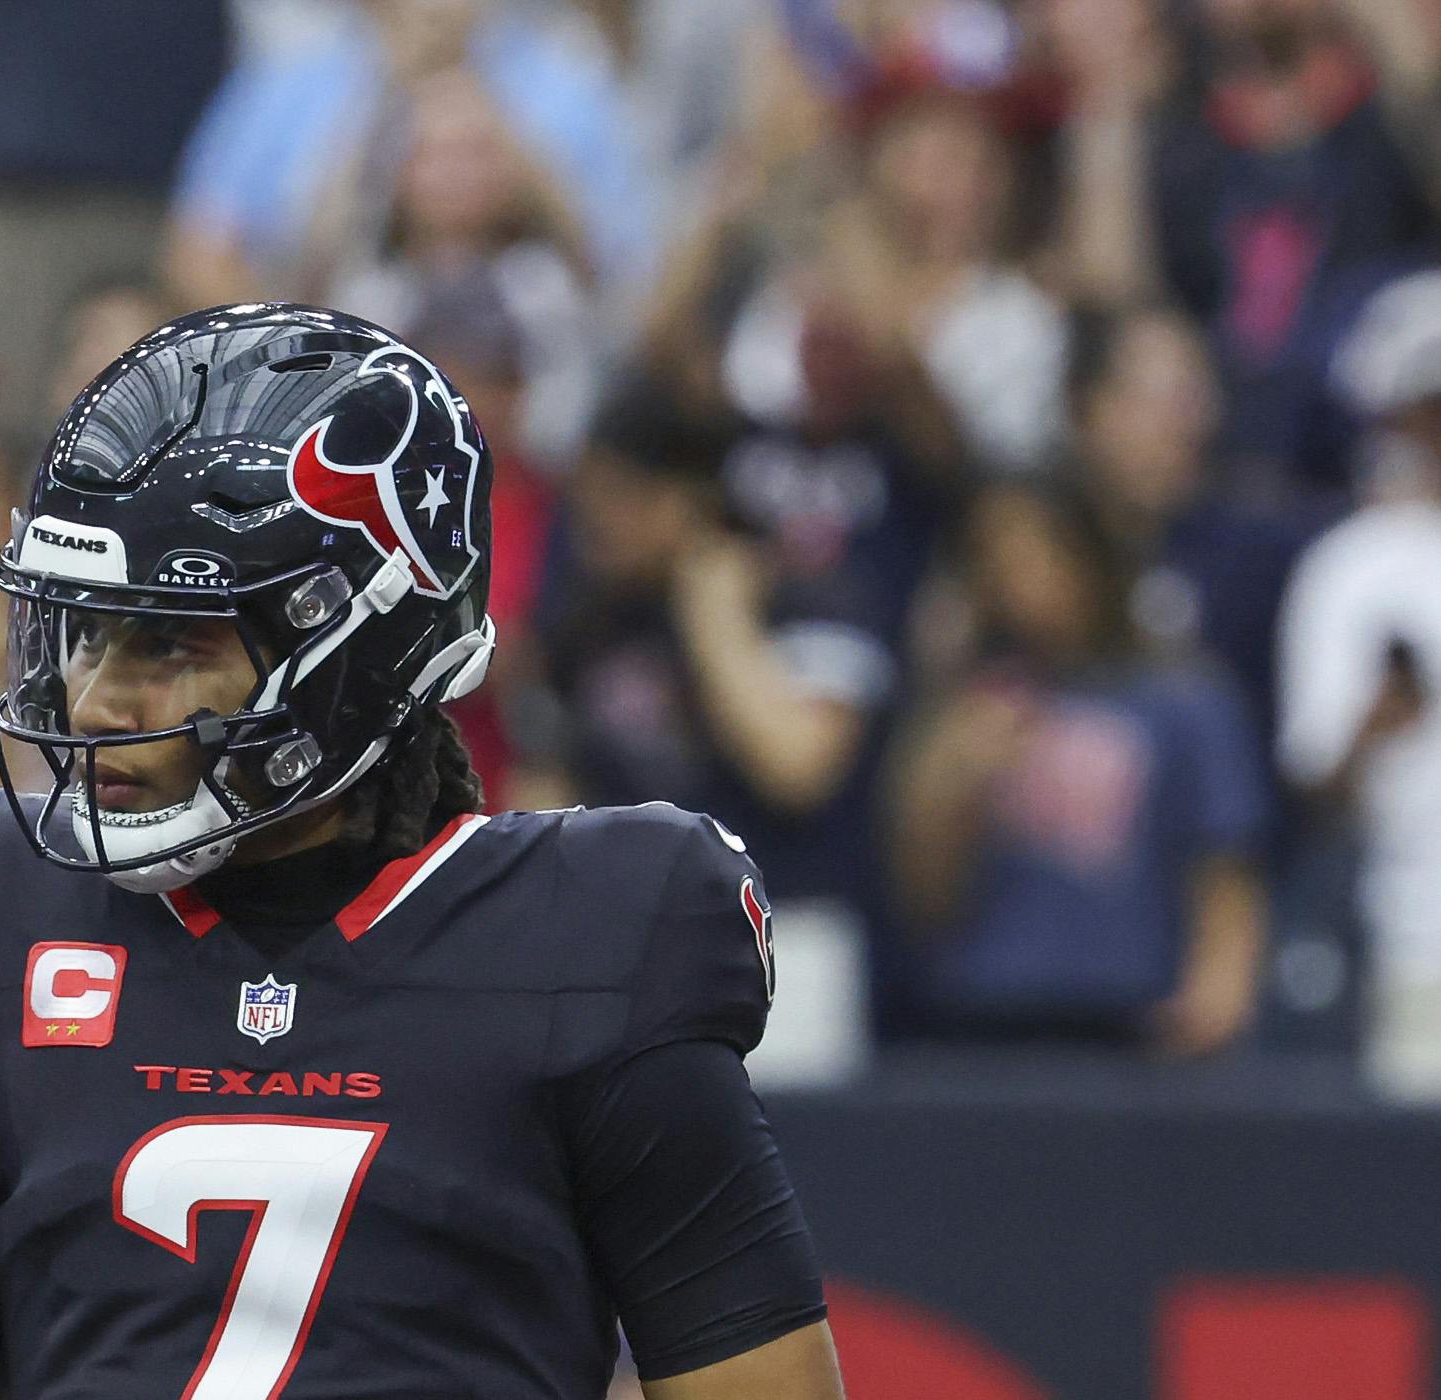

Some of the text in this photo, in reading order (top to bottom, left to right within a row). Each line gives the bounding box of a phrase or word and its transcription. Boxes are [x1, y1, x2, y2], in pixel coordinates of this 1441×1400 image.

[31, 526, 108, 553] TEXANS
[159, 573, 232, 587] OAKLEY
[31, 948, 117, 1019] C
[247, 1006, 283, 1029] NFL
[133, 1064, 383, 1099] TEXANS
